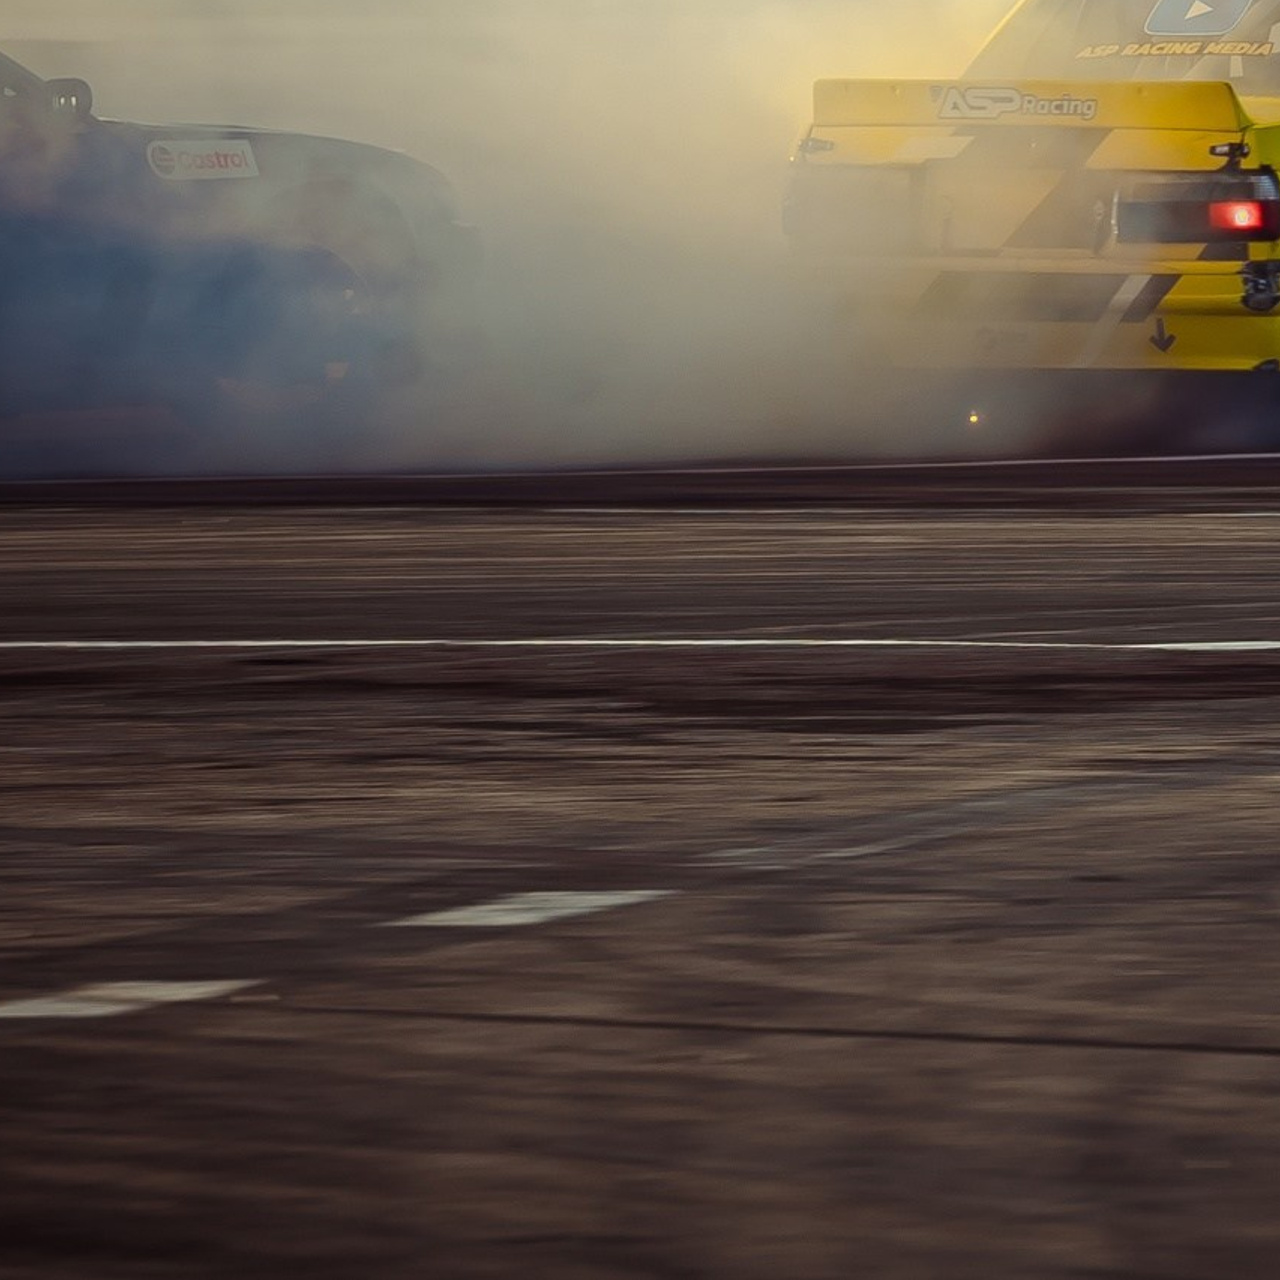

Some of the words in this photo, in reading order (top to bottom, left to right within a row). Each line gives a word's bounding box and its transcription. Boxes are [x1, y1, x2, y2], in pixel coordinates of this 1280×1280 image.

[1121, 41, 1202, 57] RACING
[1203, 41, 1274, 57] MEDIA
[938, 86, 1023, 120] ASP
[1021, 93, 1099, 121] Racing
